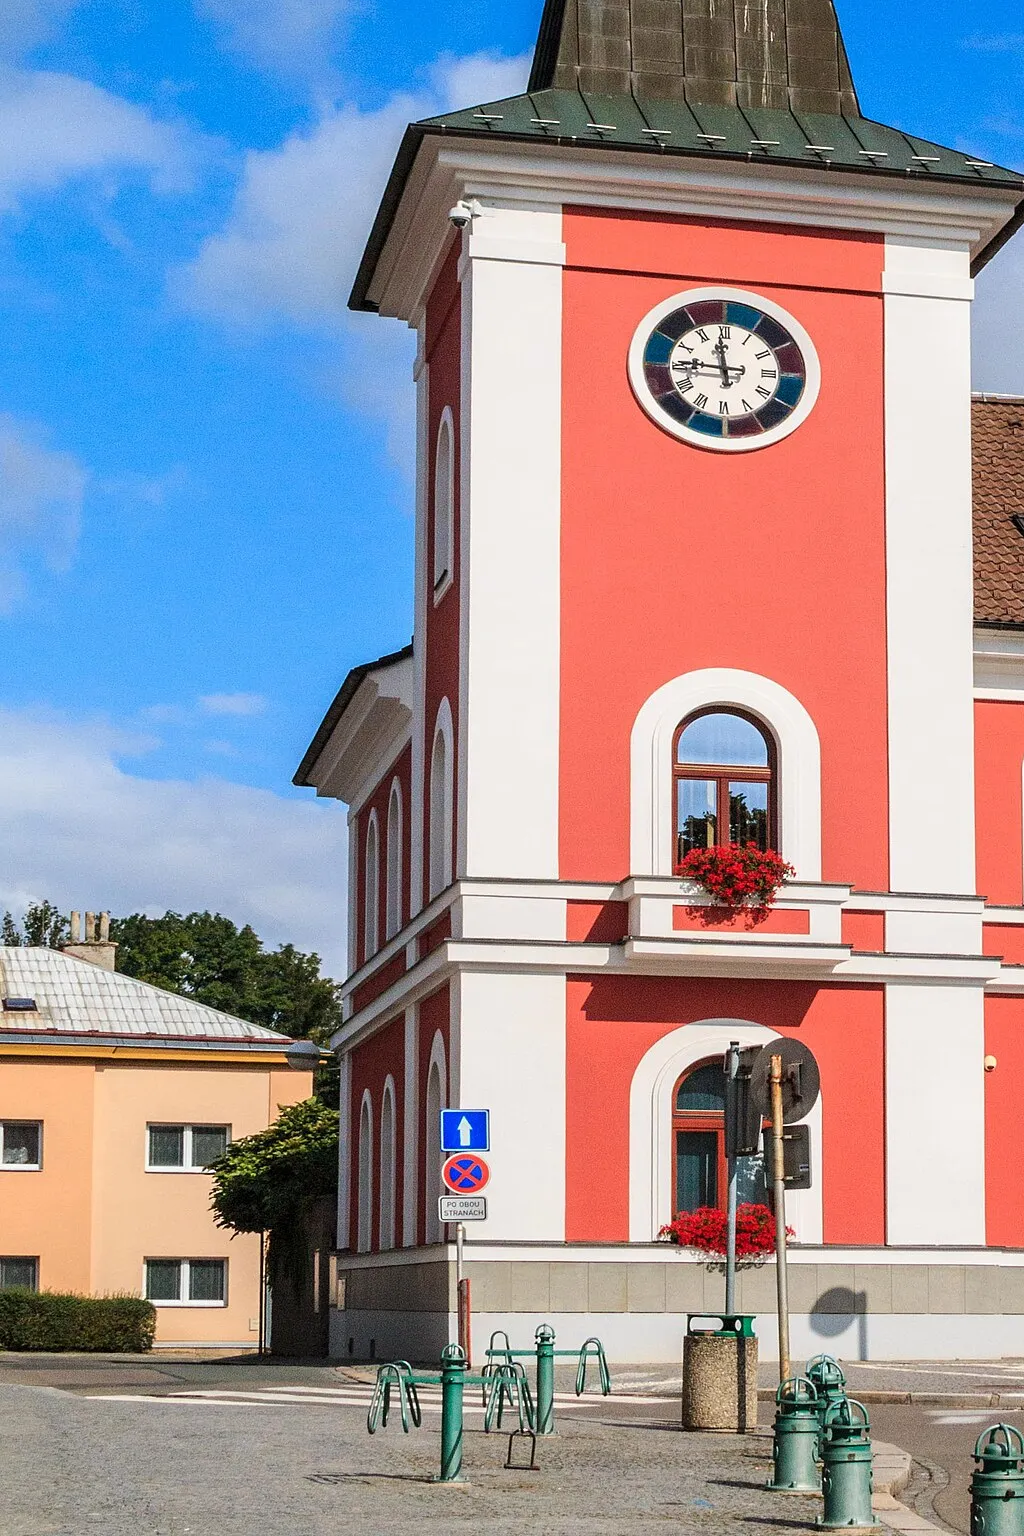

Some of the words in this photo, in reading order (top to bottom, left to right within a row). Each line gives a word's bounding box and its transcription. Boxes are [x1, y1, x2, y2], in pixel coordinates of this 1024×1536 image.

[695, 328, 710, 343] XI
[718, 326, 731, 339] XII
[742, 334, 752, 345] I
[678, 342, 694, 354] X
[755, 350, 771, 360] II
[761, 369, 776, 378] III
[675, 377, 694, 394] VIII
[755, 385, 771, 400] IV
[693, 393, 709, 409] VII
[741, 399, 753, 412] V
[719, 401, 729, 415] VI
